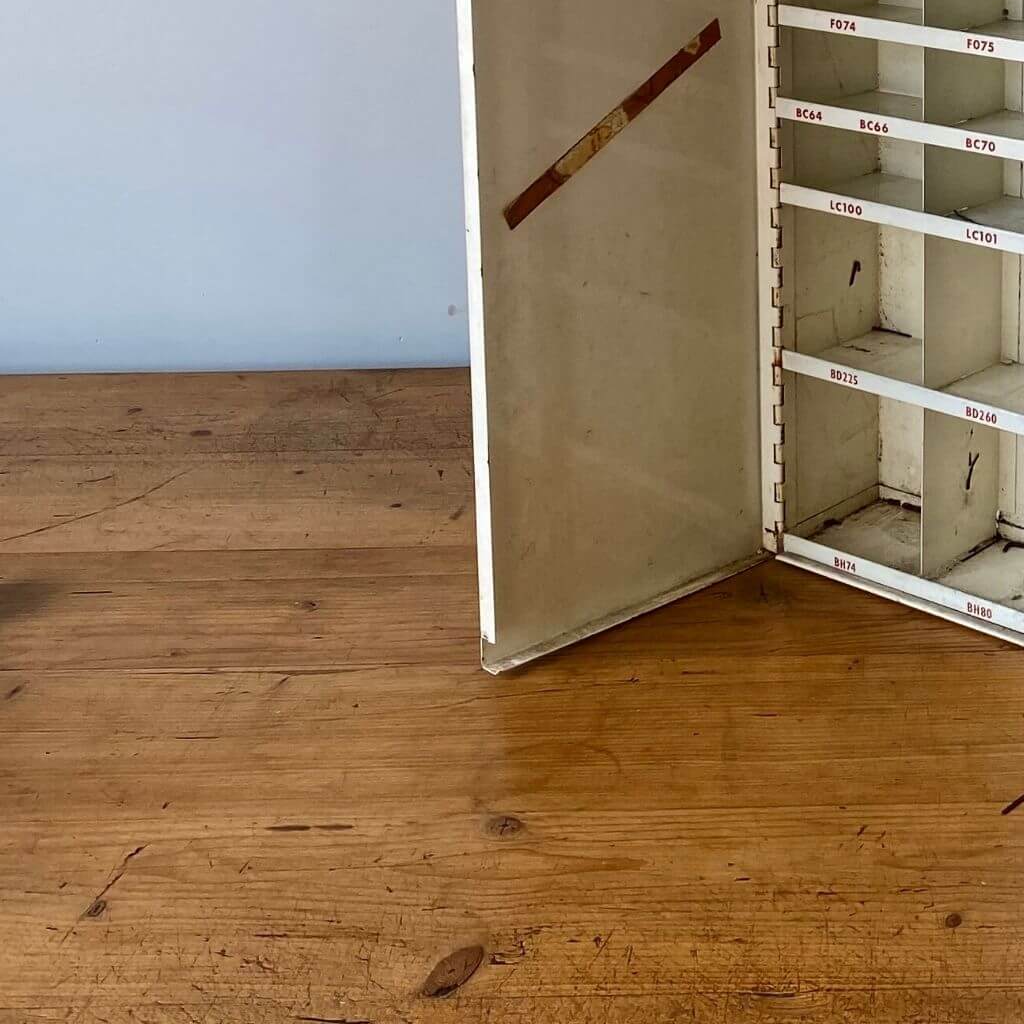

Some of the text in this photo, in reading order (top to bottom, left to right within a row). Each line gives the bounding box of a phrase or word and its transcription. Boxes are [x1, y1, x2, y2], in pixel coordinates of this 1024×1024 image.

[795, 108, 823, 122] BC64
[859, 119, 889, 134] BC66
[965, 138, 996, 153] BC70
[830, 200, 863, 216] LC100
[966, 228, 997, 245] LC101
[830, 368, 858, 385] BD225
[965, 406, 998, 424] BD260
[834, 556, 856, 572] BH74
[967, 601, 993, 619] BH80
